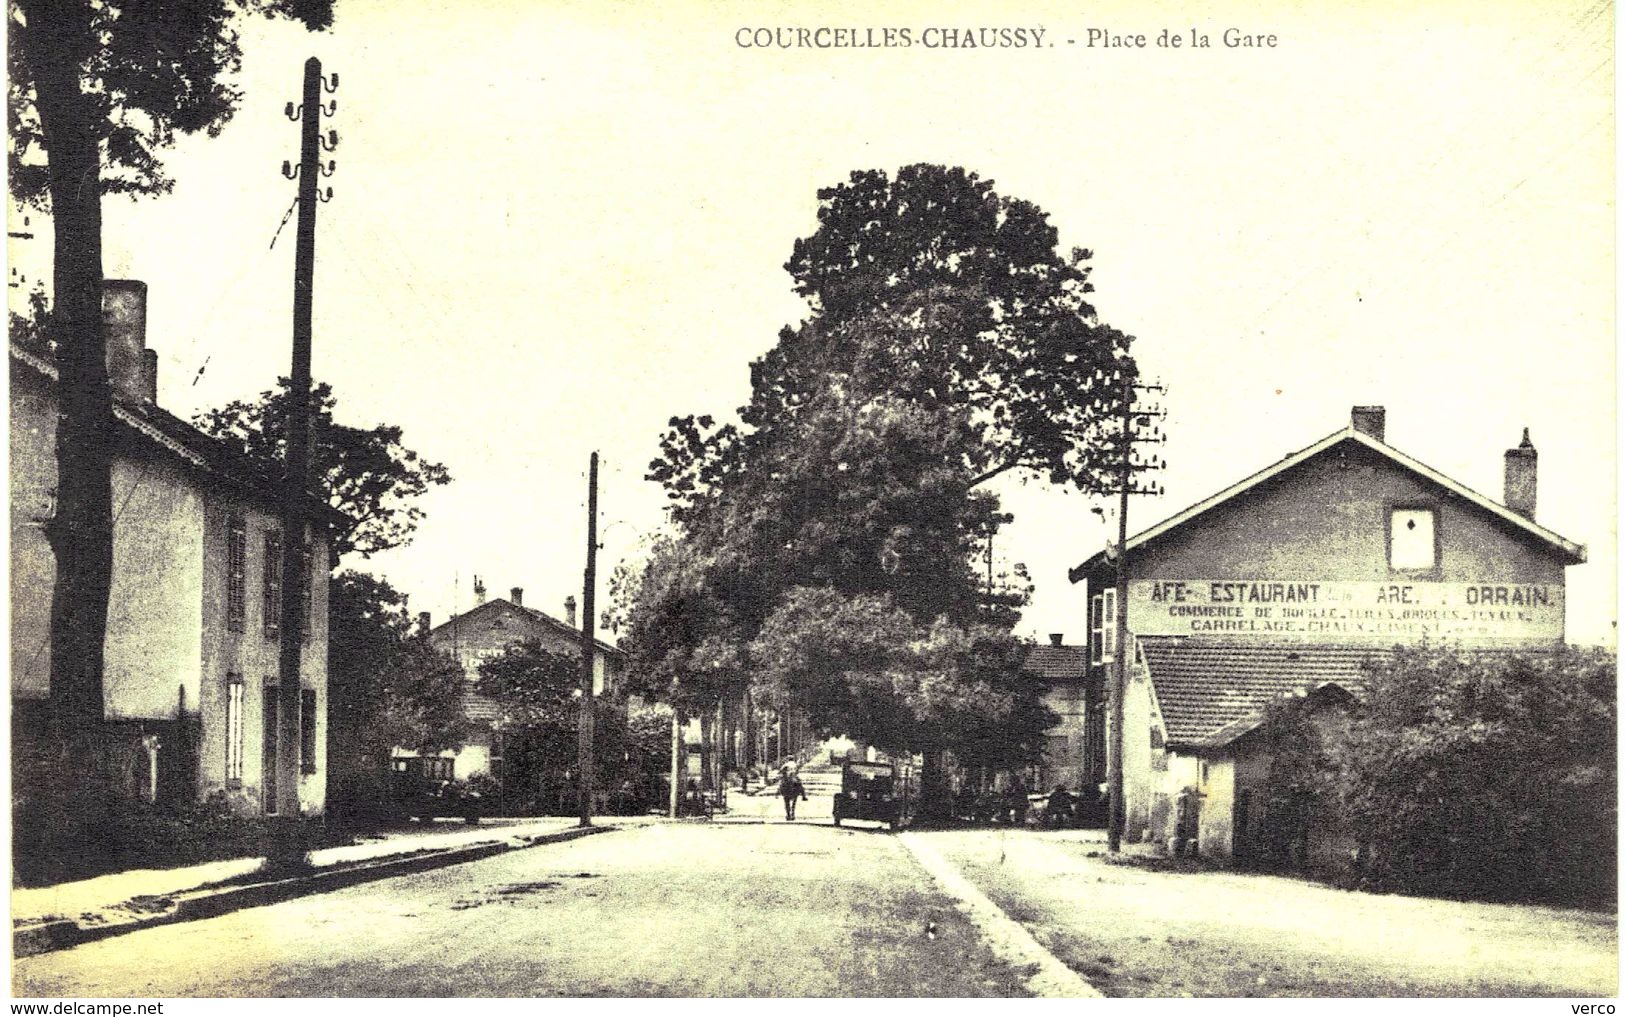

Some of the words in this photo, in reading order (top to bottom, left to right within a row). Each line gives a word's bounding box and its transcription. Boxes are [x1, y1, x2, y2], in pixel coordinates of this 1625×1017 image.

[1209, 582, 1321, 603] ESTAURANT
[1168, 605, 1244, 618] COMMERCE
[1254, 605, 1273, 618] DE
